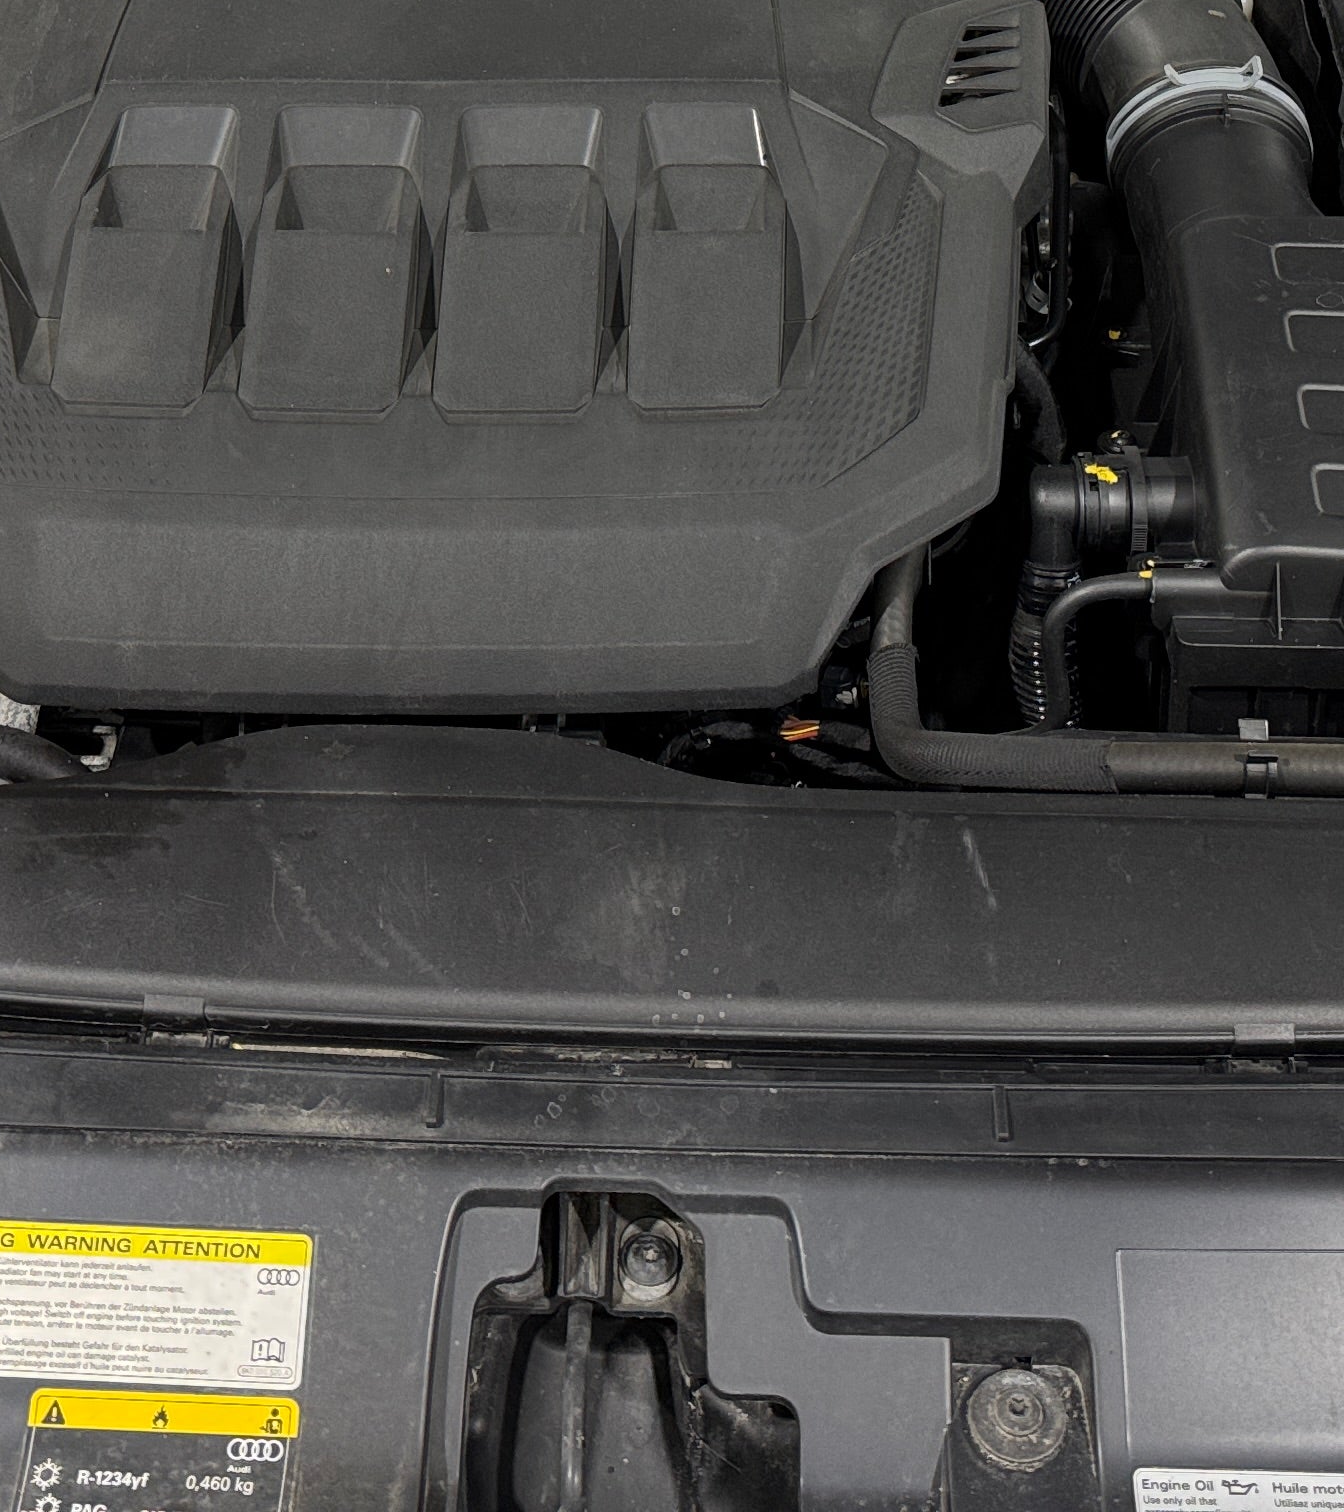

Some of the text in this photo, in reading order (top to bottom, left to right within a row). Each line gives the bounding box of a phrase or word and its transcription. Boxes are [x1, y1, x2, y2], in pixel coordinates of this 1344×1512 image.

[28, 1233, 131, 1253] WARNING
[143, 1239, 260, 1259] ATTENTION
[76, 1470, 254, 1496] R-1234yf 0,460 kg
[1141, 1479, 1190, 1492] Engine
